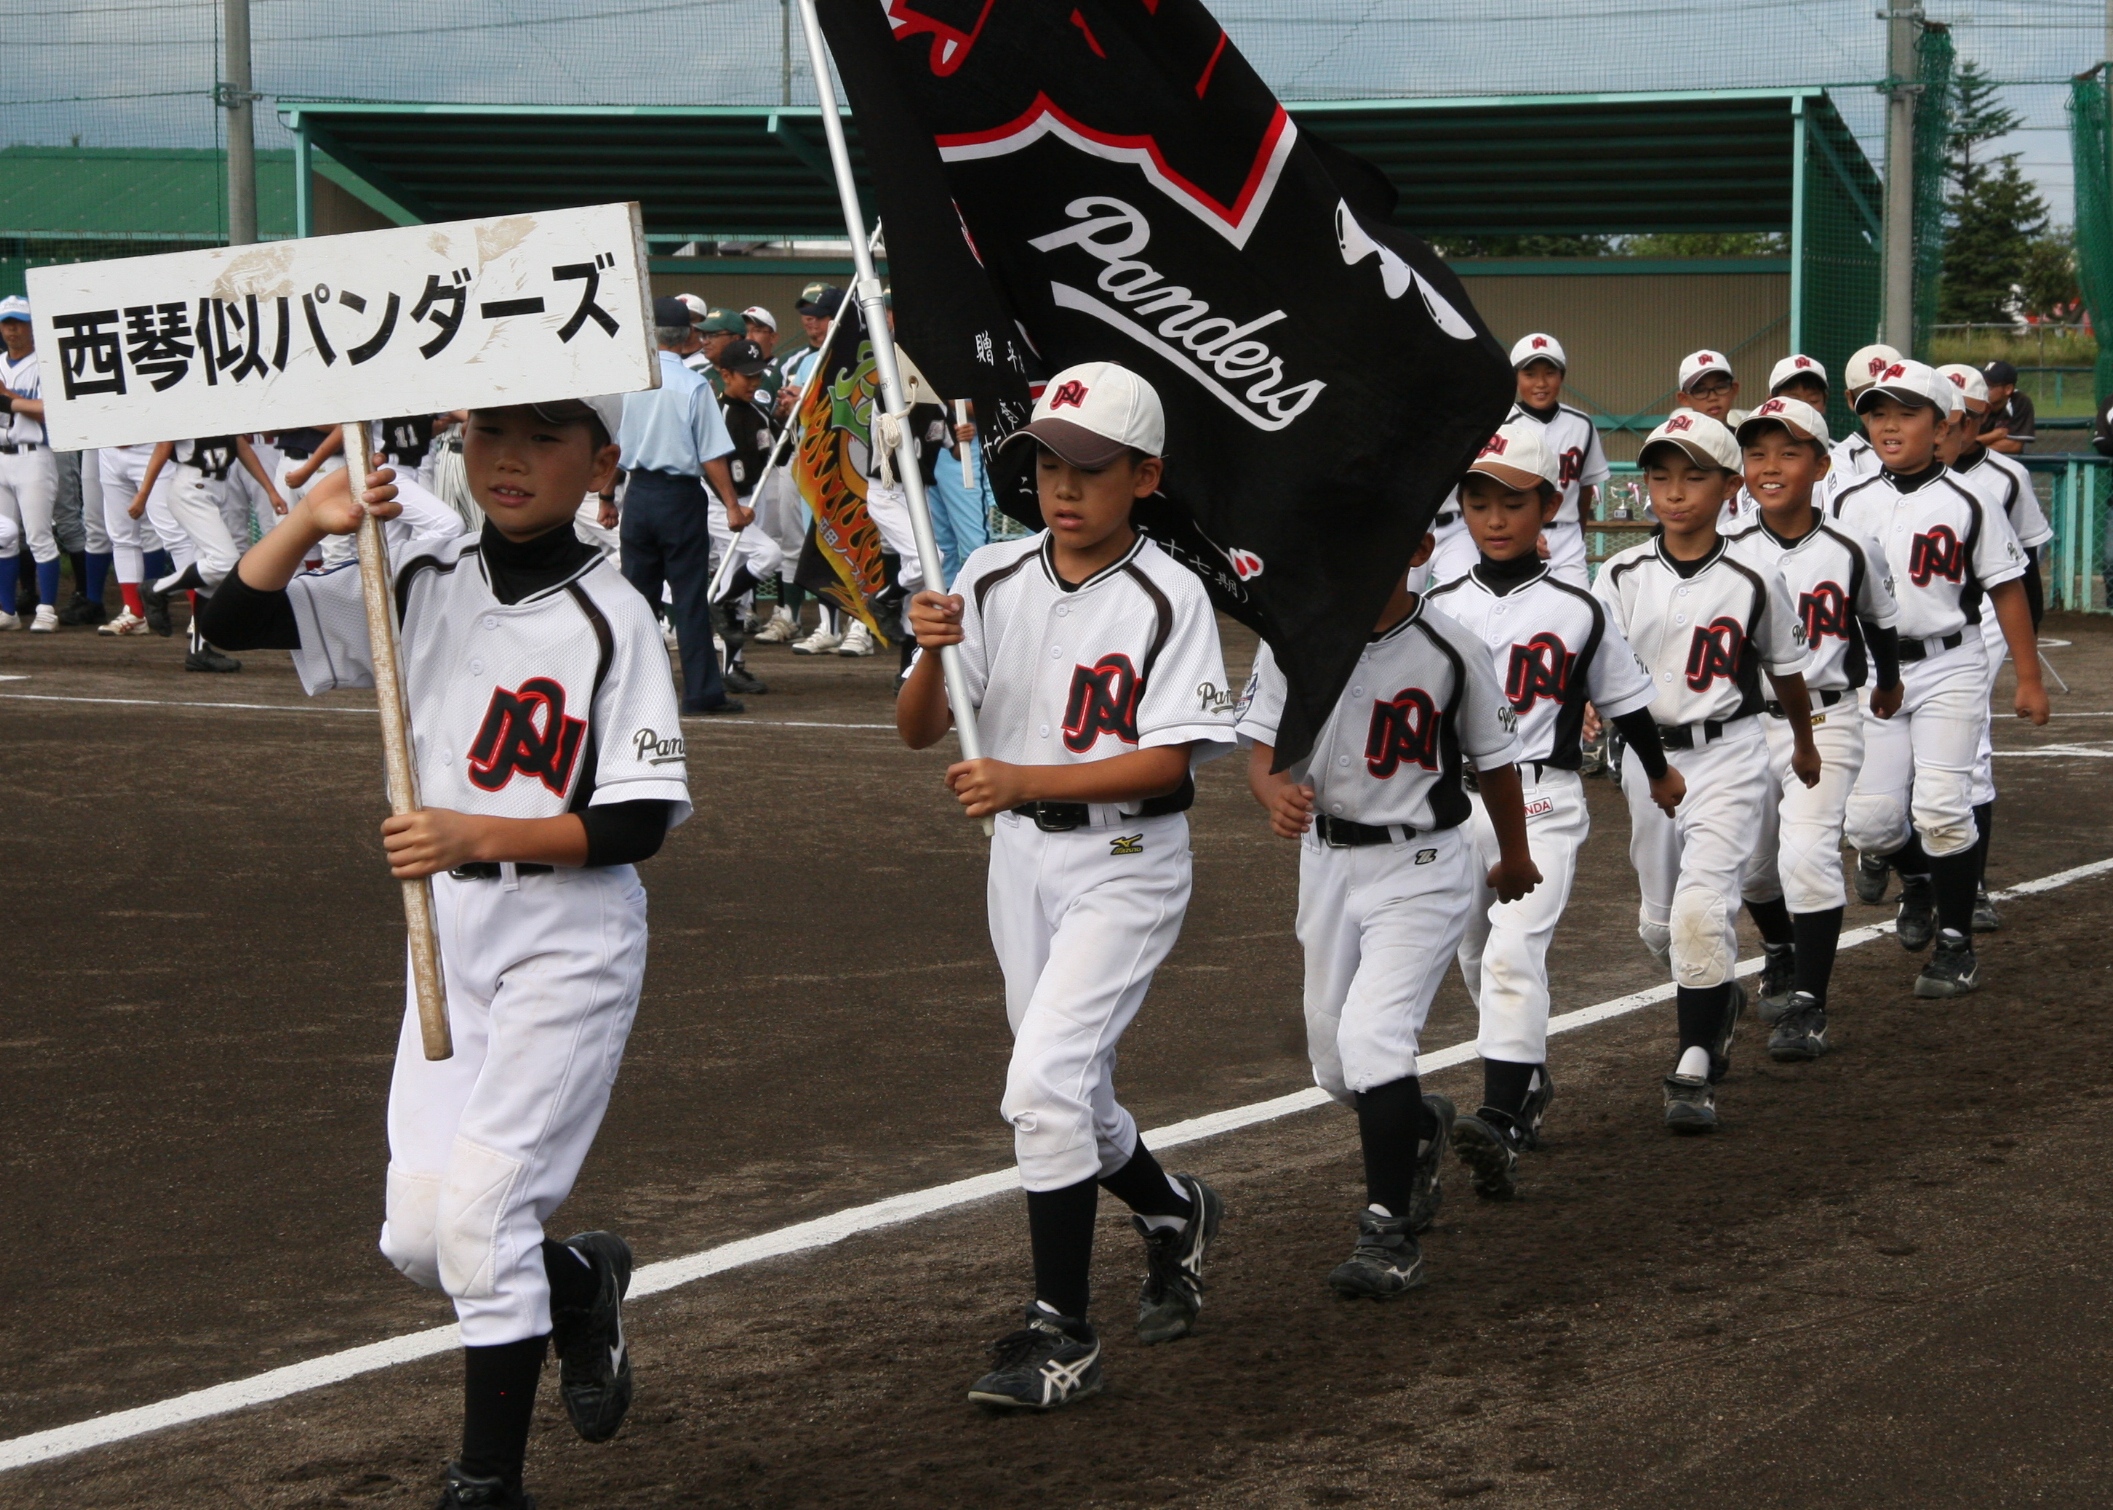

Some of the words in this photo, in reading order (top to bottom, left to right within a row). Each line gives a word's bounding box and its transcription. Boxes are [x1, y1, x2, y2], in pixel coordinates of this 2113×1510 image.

[53, 251, 620, 401] 西琴似パンダーズ
[1028, 196, 1326, 431] Panders
[202, 447, 229, 471] 17
[731, 459, 746, 483] 6
